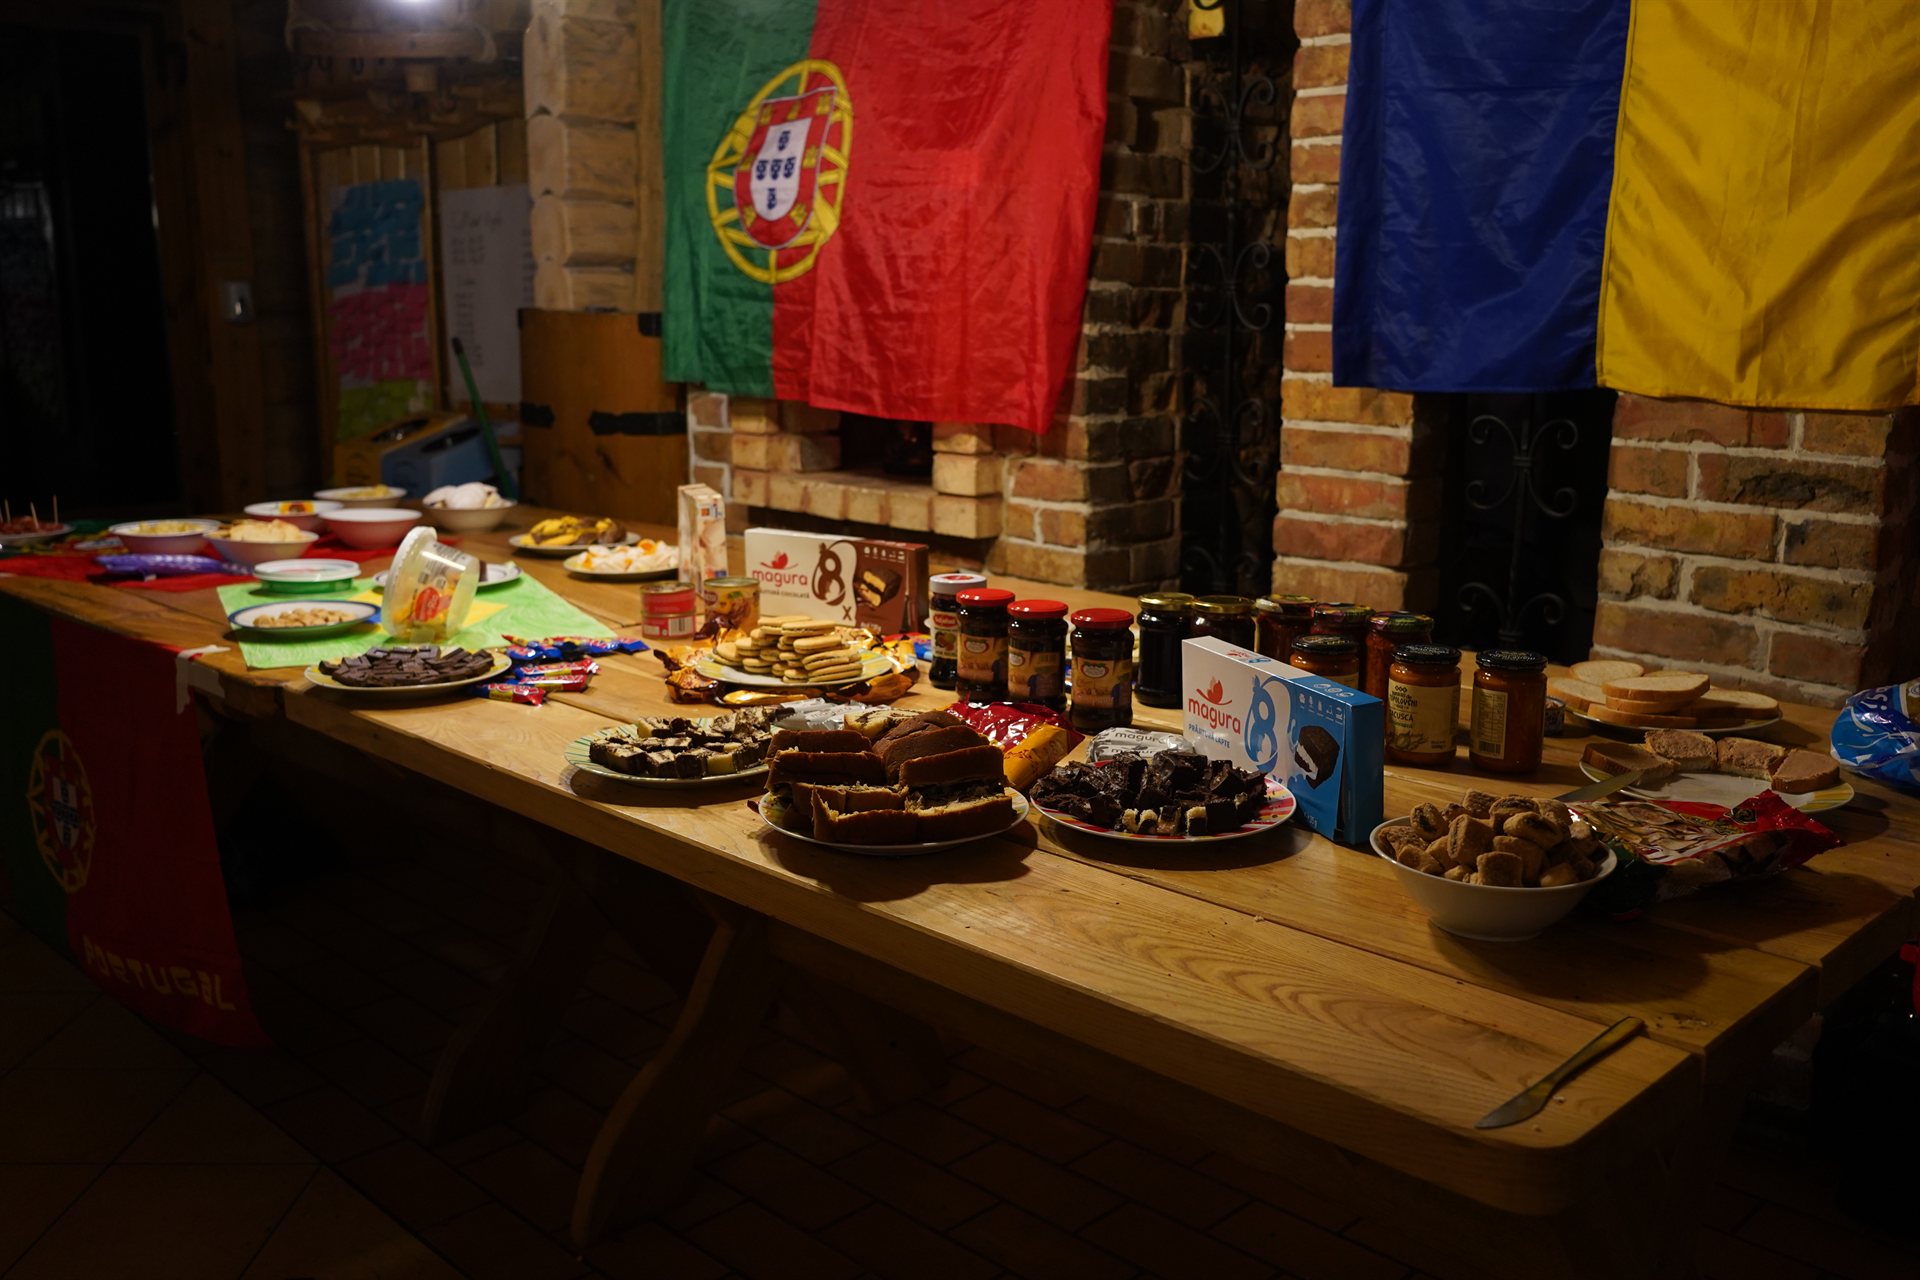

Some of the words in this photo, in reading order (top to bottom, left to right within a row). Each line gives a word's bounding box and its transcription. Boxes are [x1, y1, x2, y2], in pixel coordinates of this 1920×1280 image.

[752, 570, 808, 587] magura
[1188, 698, 1241, 734] magura
[1244, 676, 1278, 773] 8
[82, 933, 237, 1011] PORTUGAL
